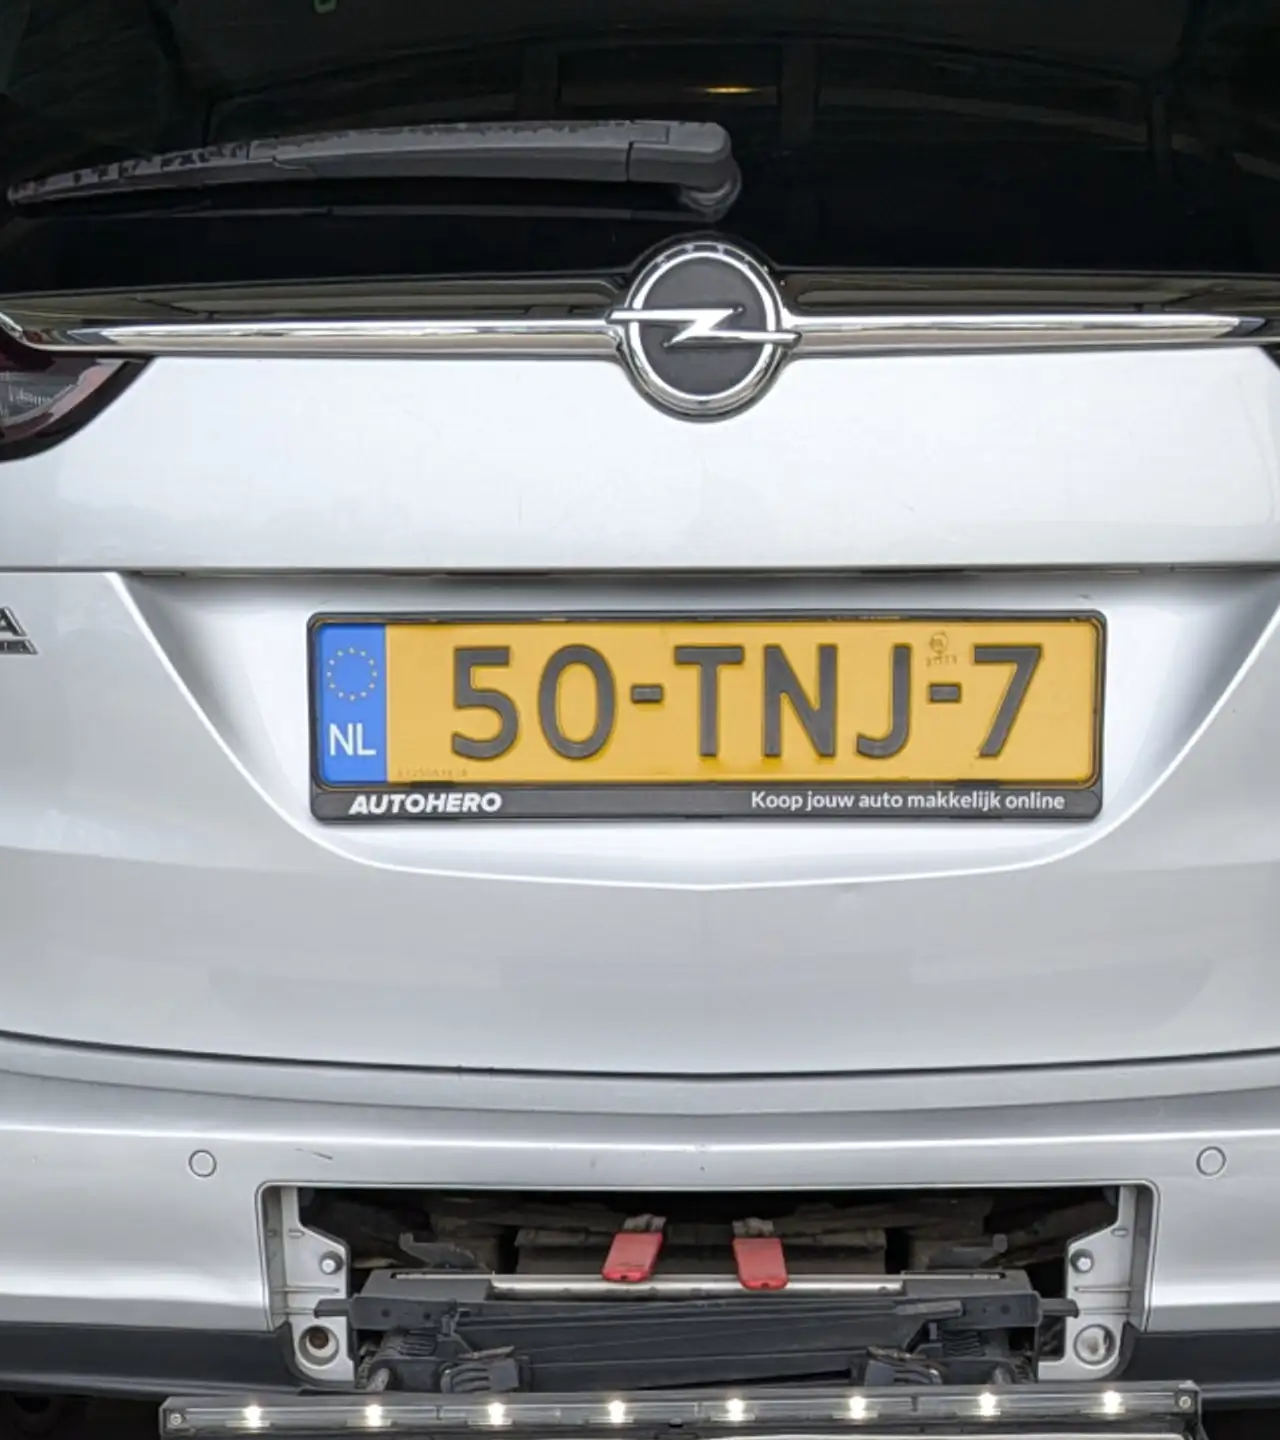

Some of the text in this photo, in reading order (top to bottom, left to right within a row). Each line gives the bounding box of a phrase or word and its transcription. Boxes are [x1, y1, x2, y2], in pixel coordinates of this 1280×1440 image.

[451, 643, 1043, 762] 50-TNJ-7
[329, 723, 377, 756] NL
[348, 792, 503, 815] AUTOHERO
[751, 791, 1065, 812] Koop jouw auto makkelijk online
